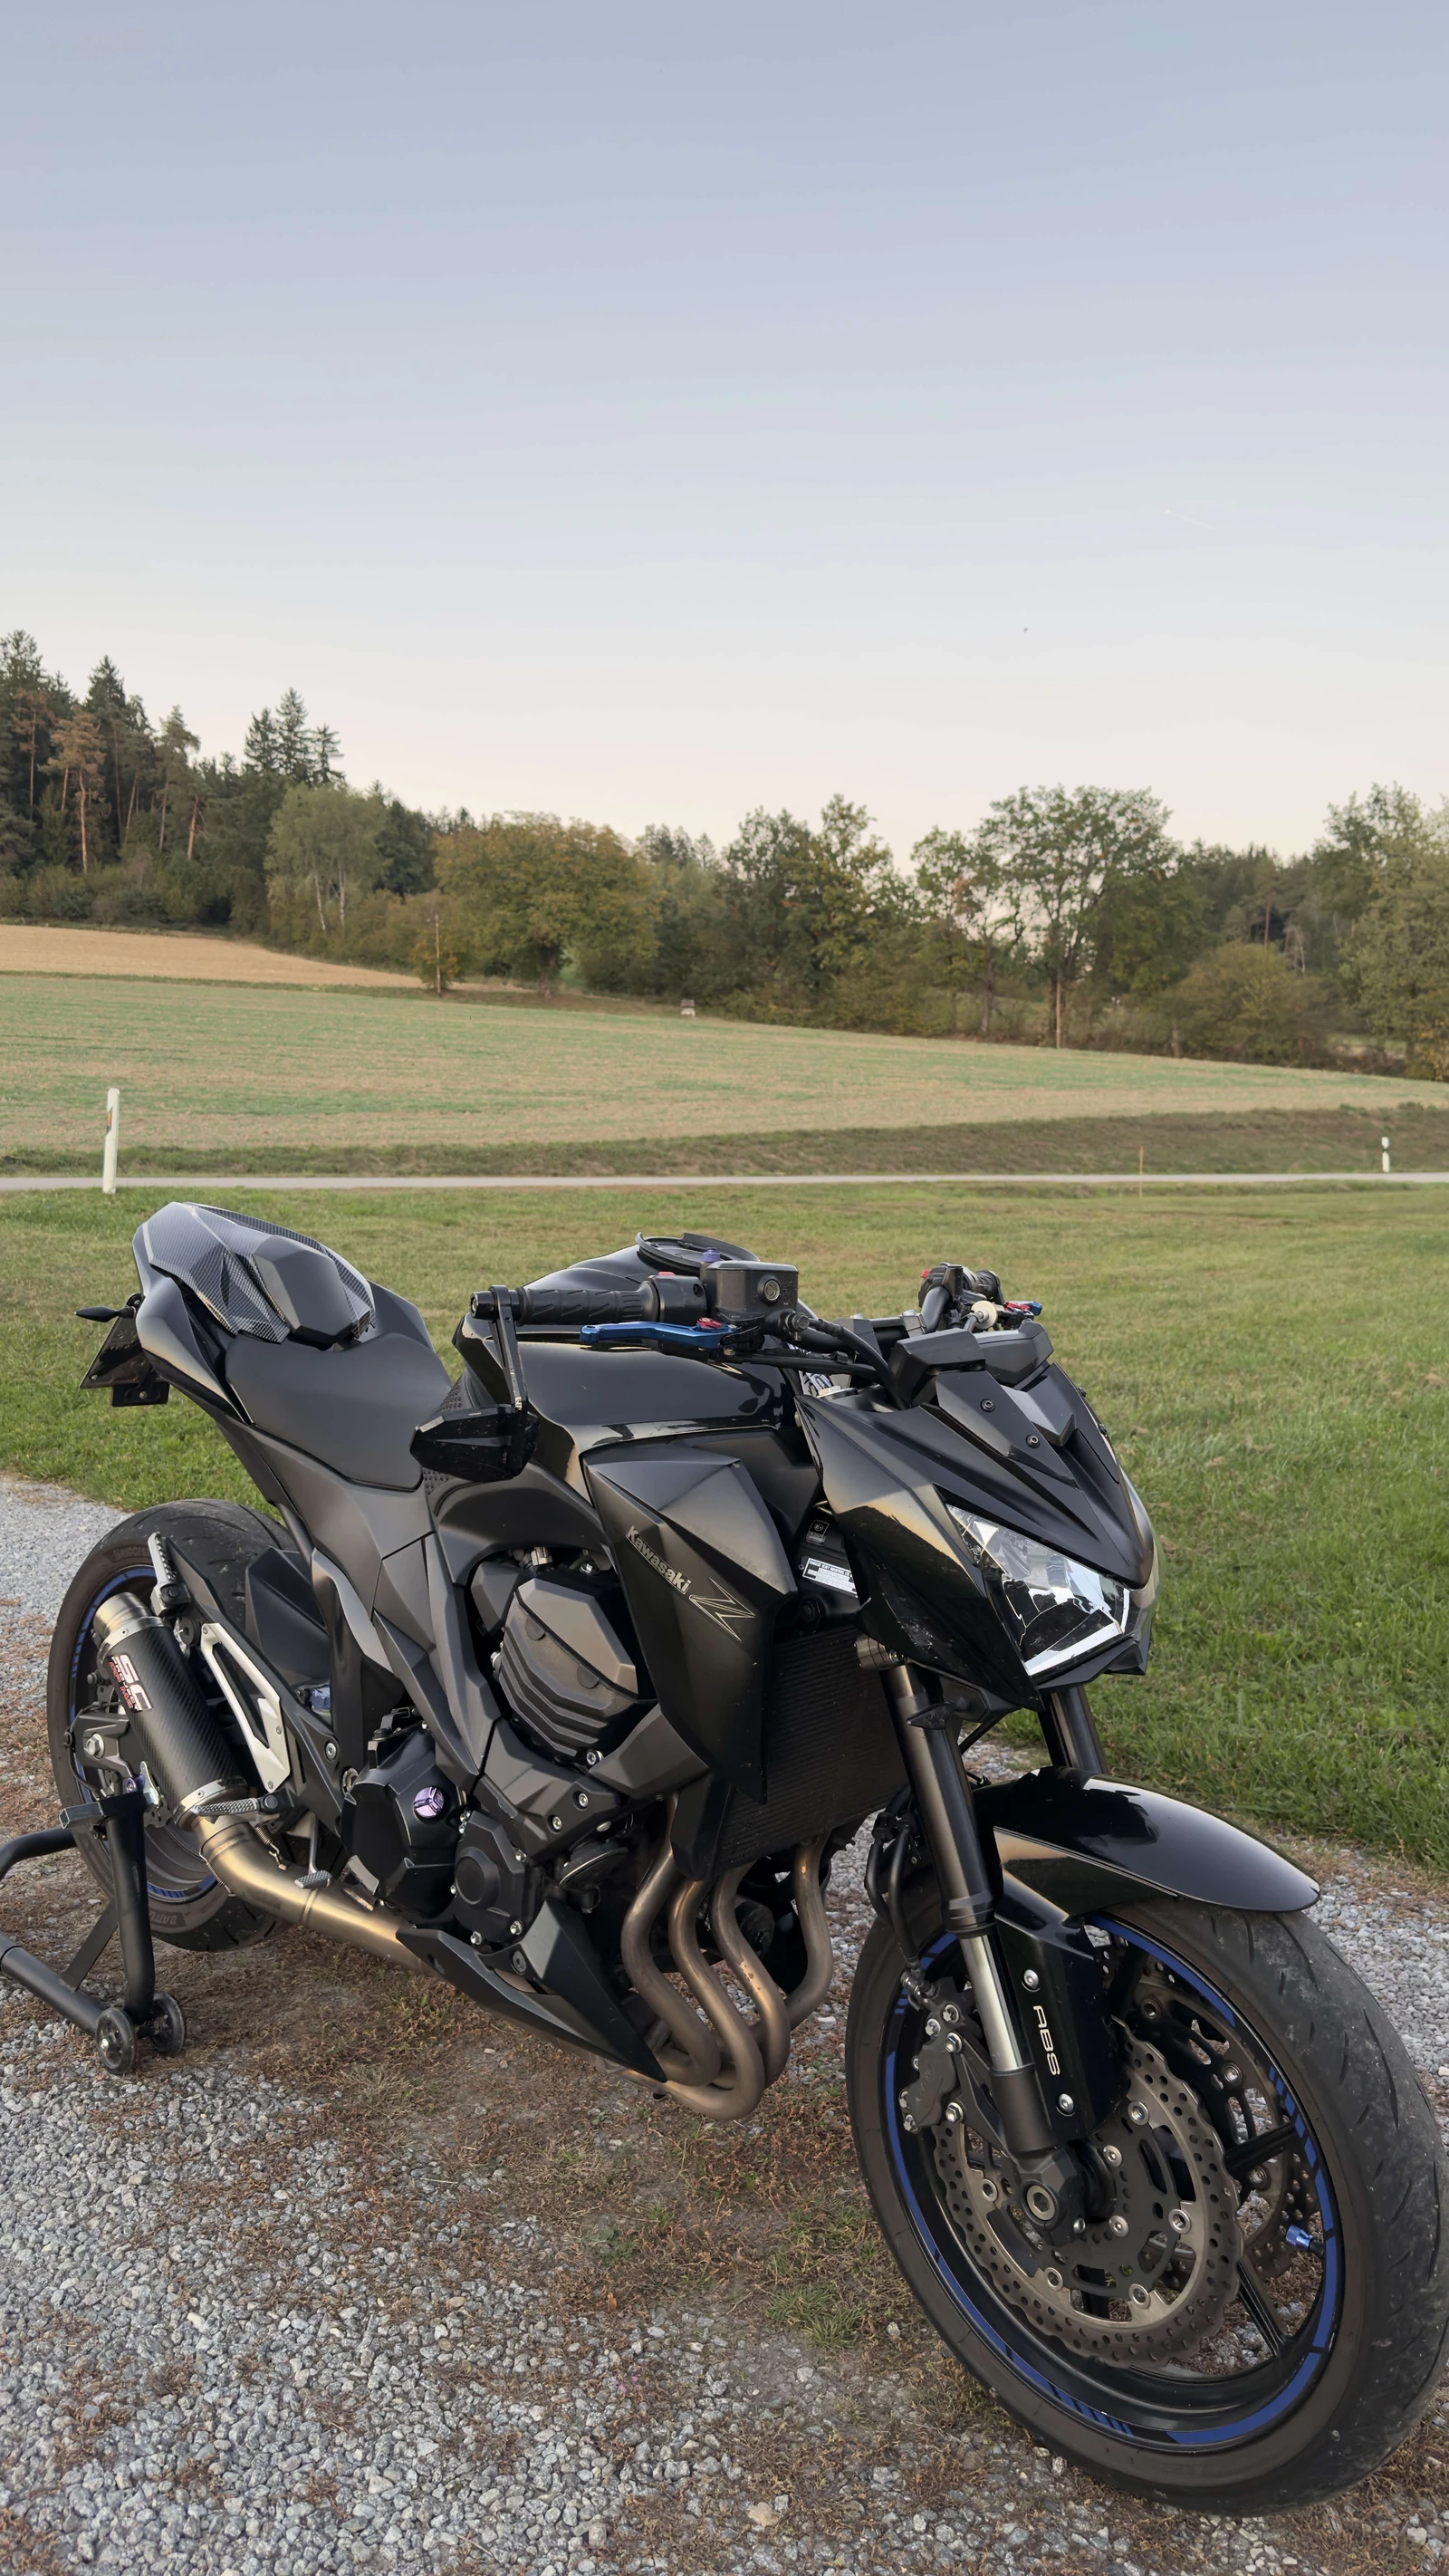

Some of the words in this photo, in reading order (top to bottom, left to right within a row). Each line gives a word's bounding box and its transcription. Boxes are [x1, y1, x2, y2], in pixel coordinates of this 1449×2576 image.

[626, 1525, 691, 1594] Kawasaki
[688, 1577, 756, 1642] Z
[115, 1654, 152, 1711] SC
[1033, 2005, 1060, 2076] ABS
